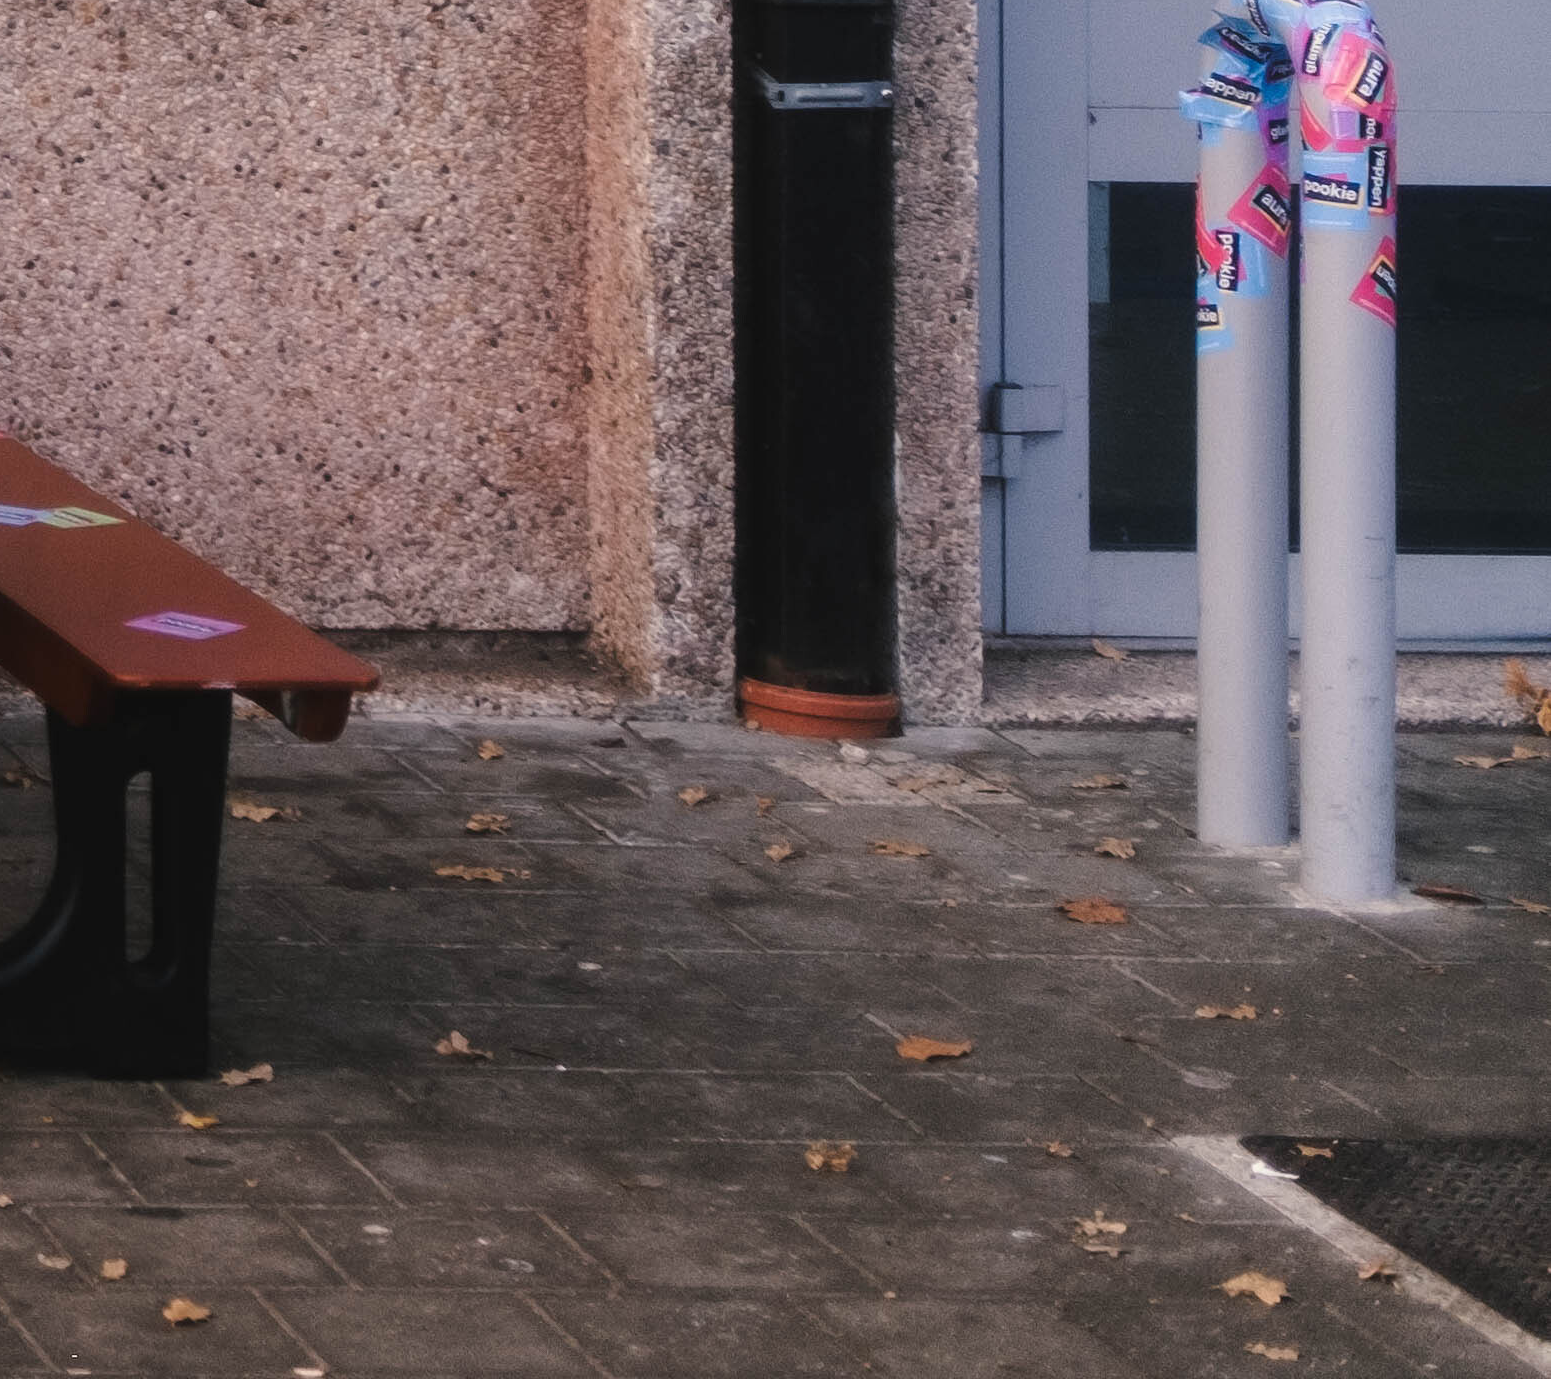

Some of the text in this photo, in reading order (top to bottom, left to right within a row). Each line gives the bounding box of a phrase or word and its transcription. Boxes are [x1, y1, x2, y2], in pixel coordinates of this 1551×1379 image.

[1358, 59, 1383, 97] aura
[1303, 180, 1359, 203] pookie
[1369, 150, 1388, 207] yappen
